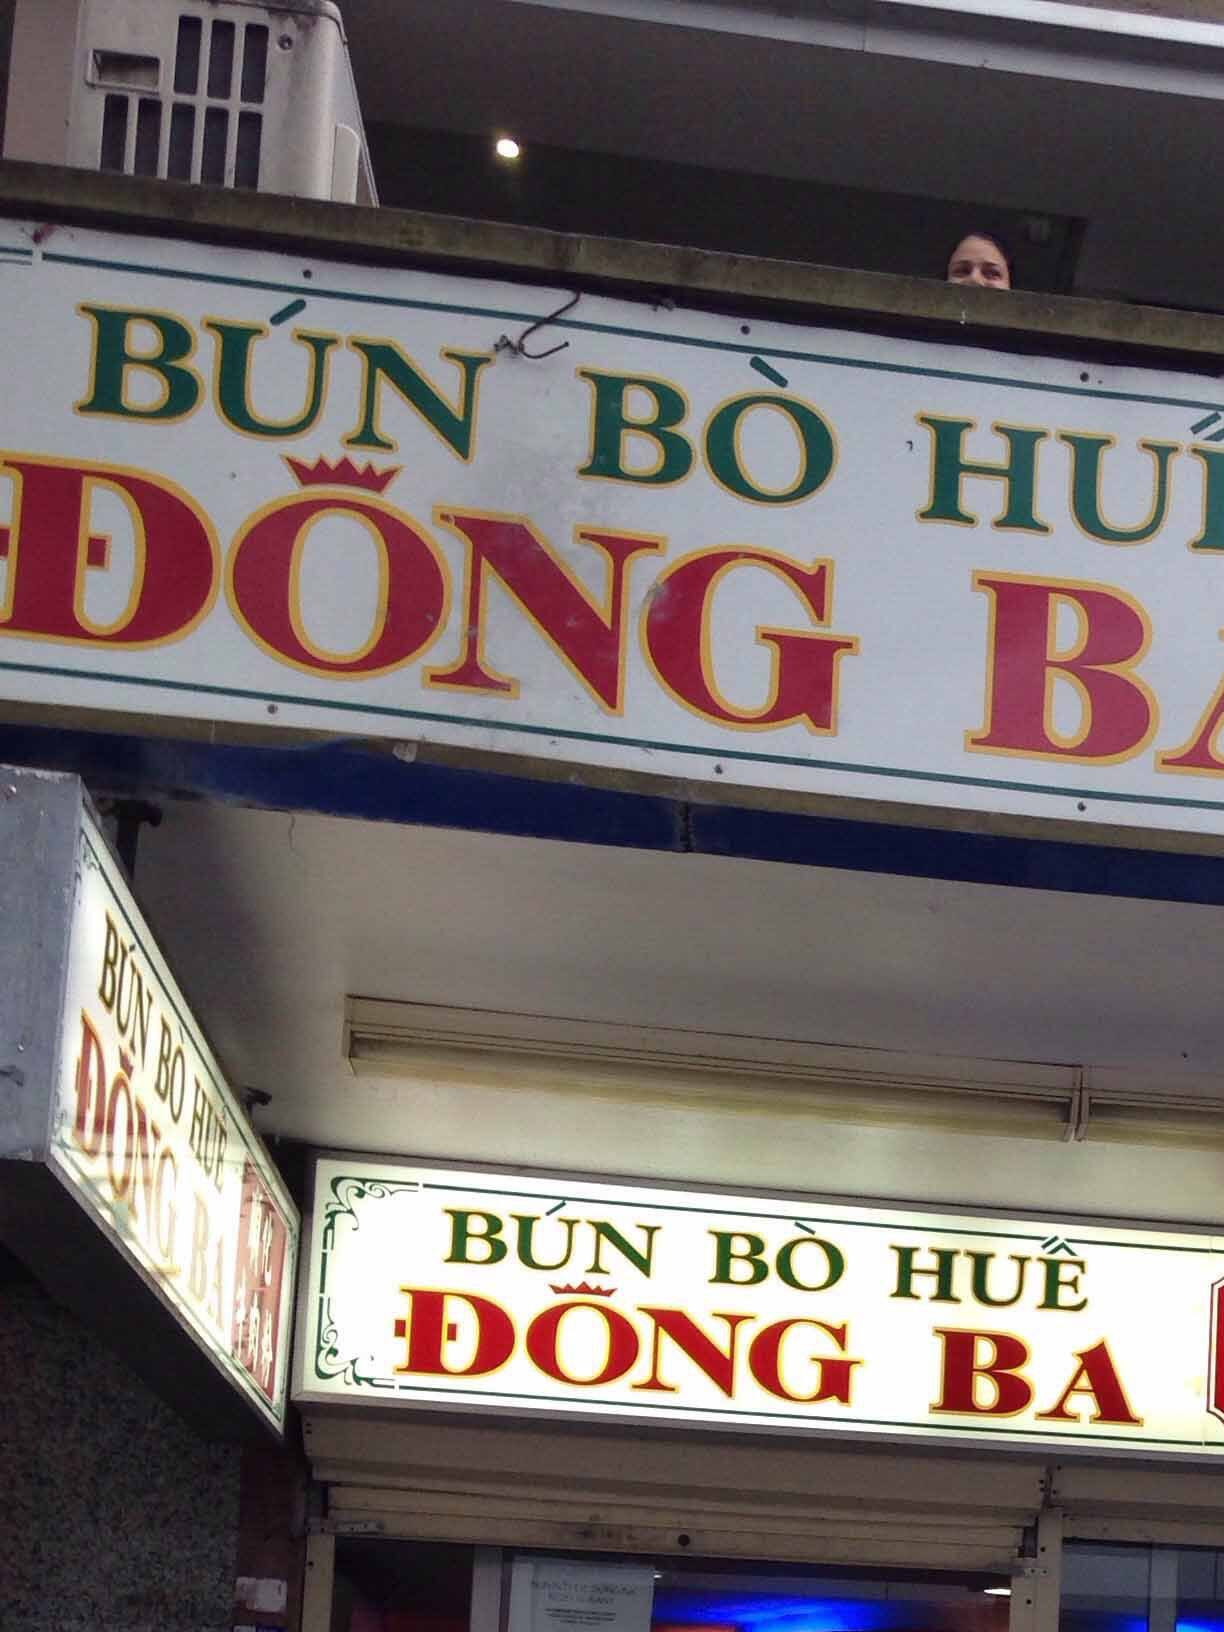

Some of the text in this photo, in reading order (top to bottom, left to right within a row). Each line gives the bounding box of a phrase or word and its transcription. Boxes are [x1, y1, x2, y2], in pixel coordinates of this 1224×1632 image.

[75, 298, 492, 463] BÚN
[576, 356, 837, 507] BÒ
[442, 1200, 662, 1279] BÚN
[707, 1221, 846, 1292] BÒ
[929, 1326, 1144, 1427] BA
